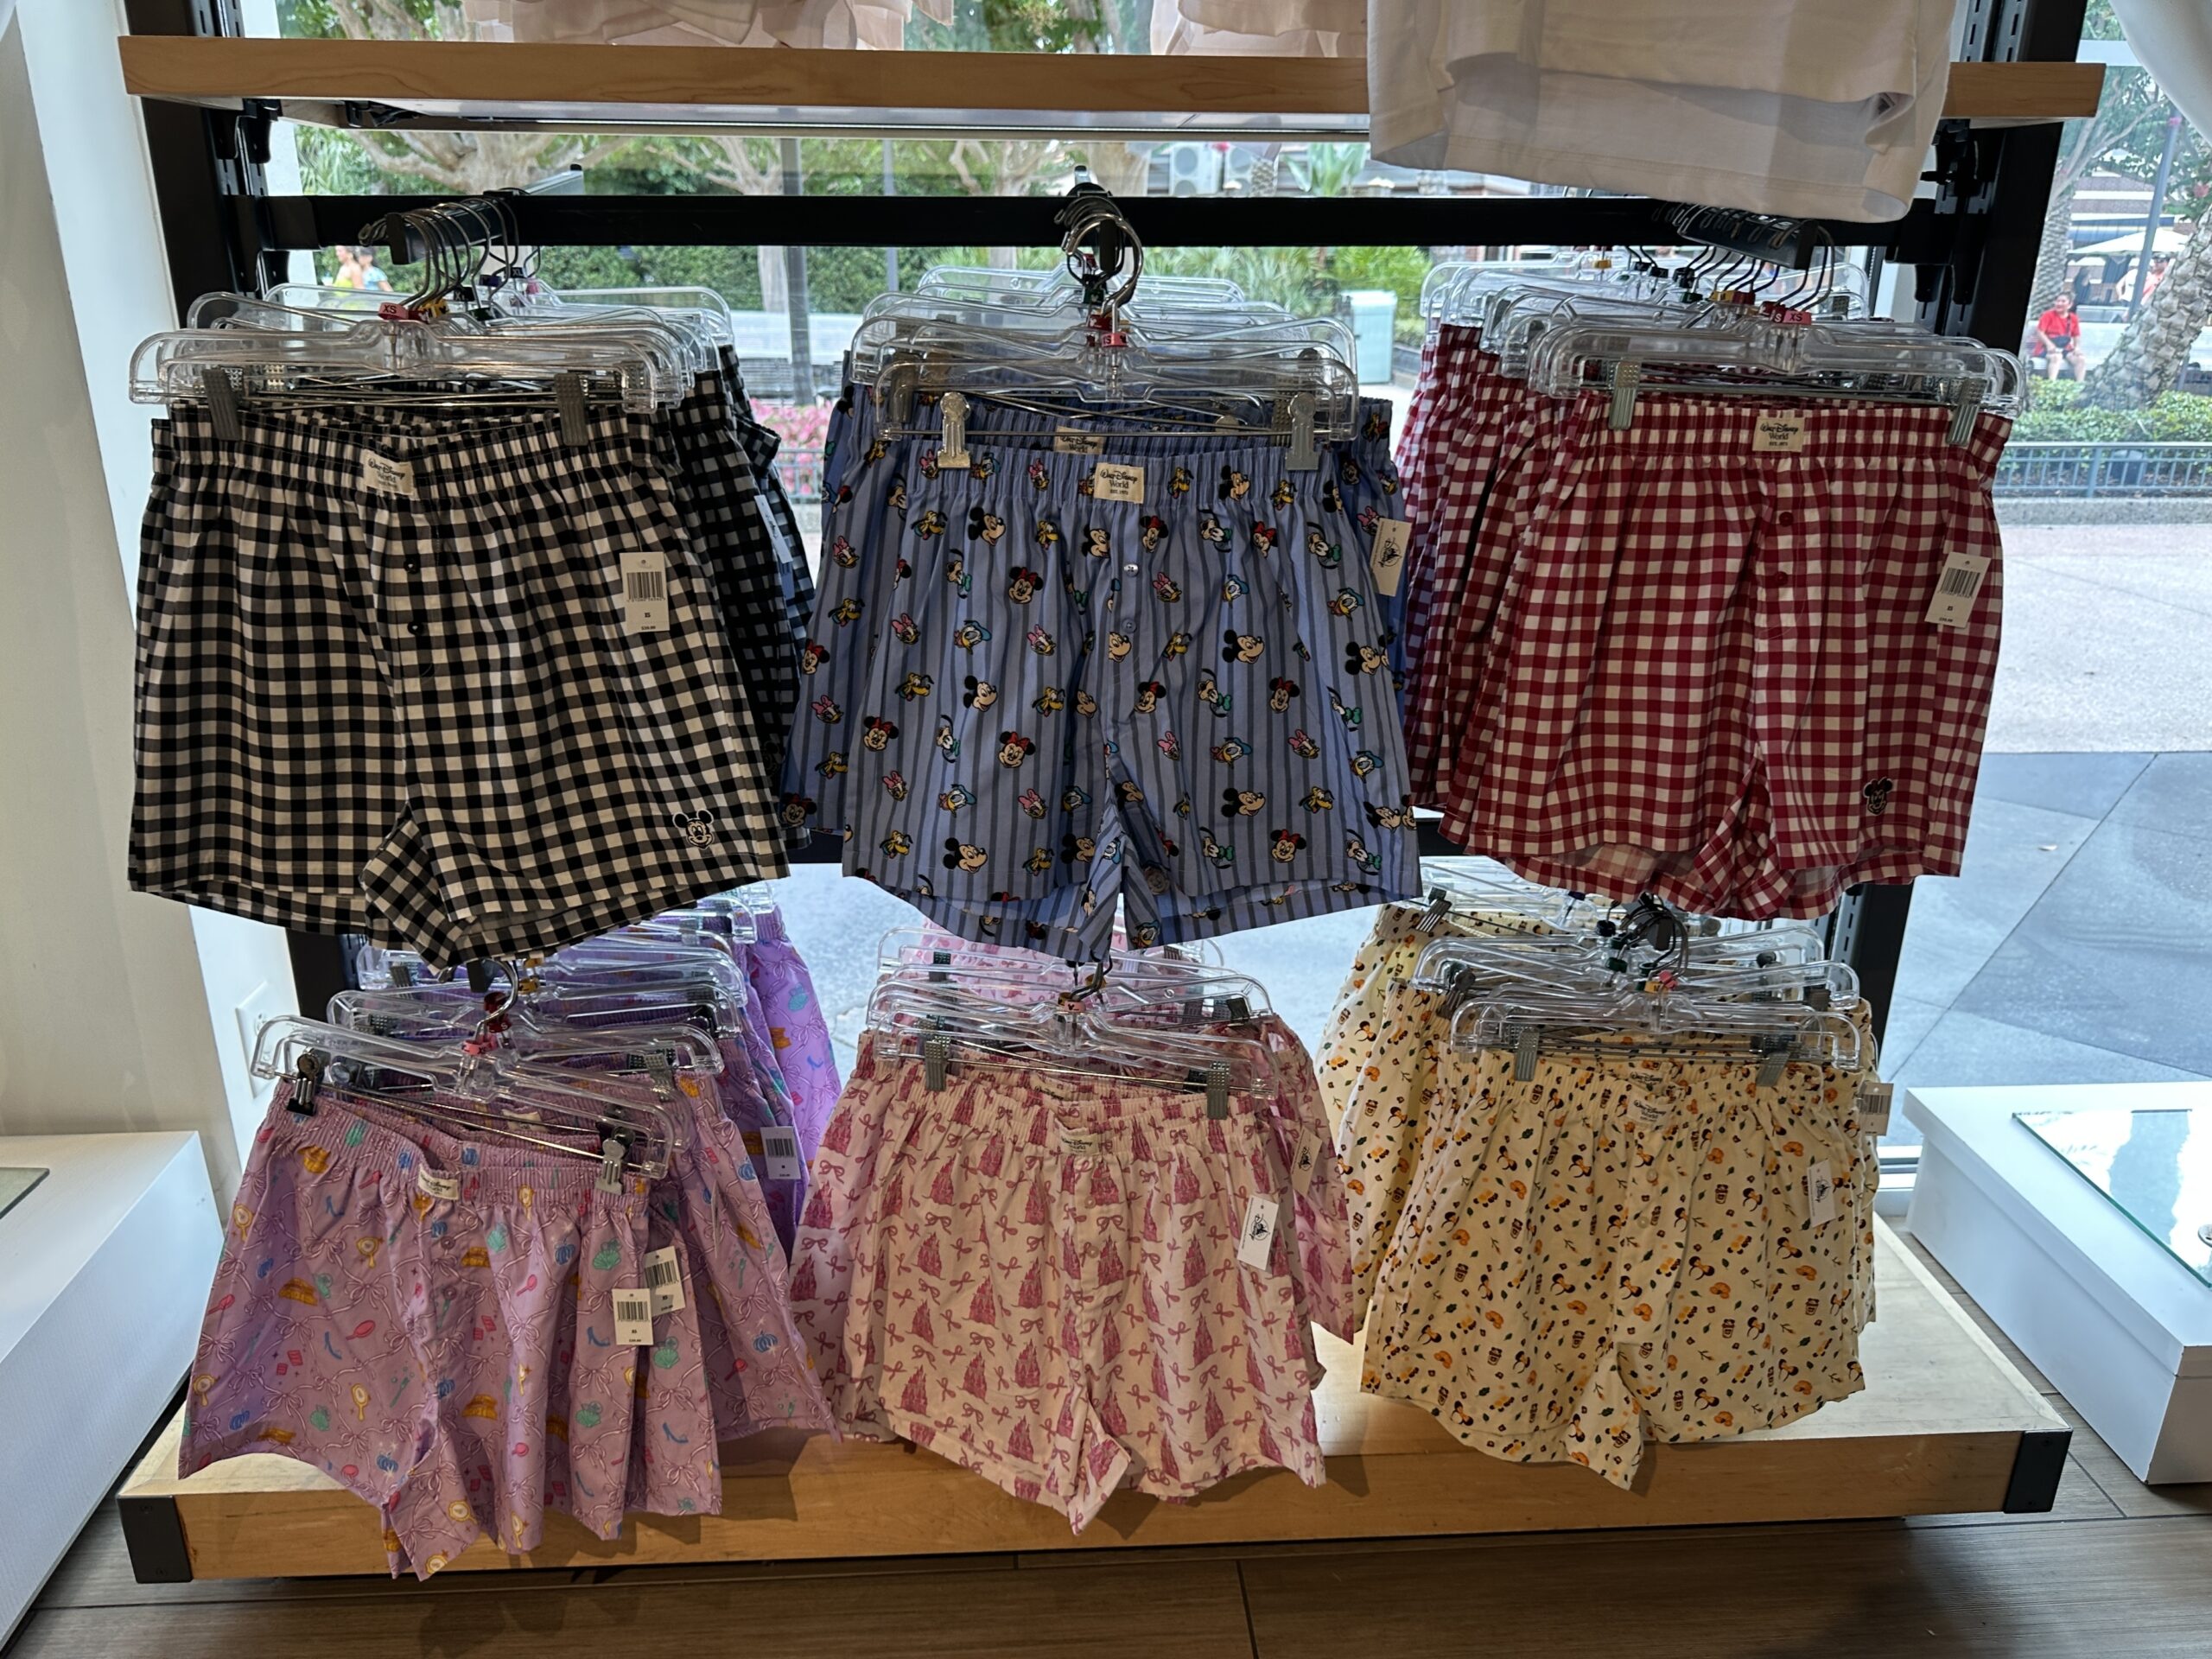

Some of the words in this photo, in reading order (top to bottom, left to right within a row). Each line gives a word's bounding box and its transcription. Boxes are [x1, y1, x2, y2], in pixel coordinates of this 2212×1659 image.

[382, 304, 397, 315] XS
[1789, 313, 1802, 322] XS
[1760, 421, 1774, 433] Walt
[1773, 423, 1799, 435] Disney
[1769, 432, 1789, 441] World
[380, 462, 405, 480] Disney
[1099, 469, 1115, 479] Walt
[1114, 470, 1138, 484] Disney
[1109, 480, 1129, 489] World
[1646, 1103, 1667, 1116] Disney
